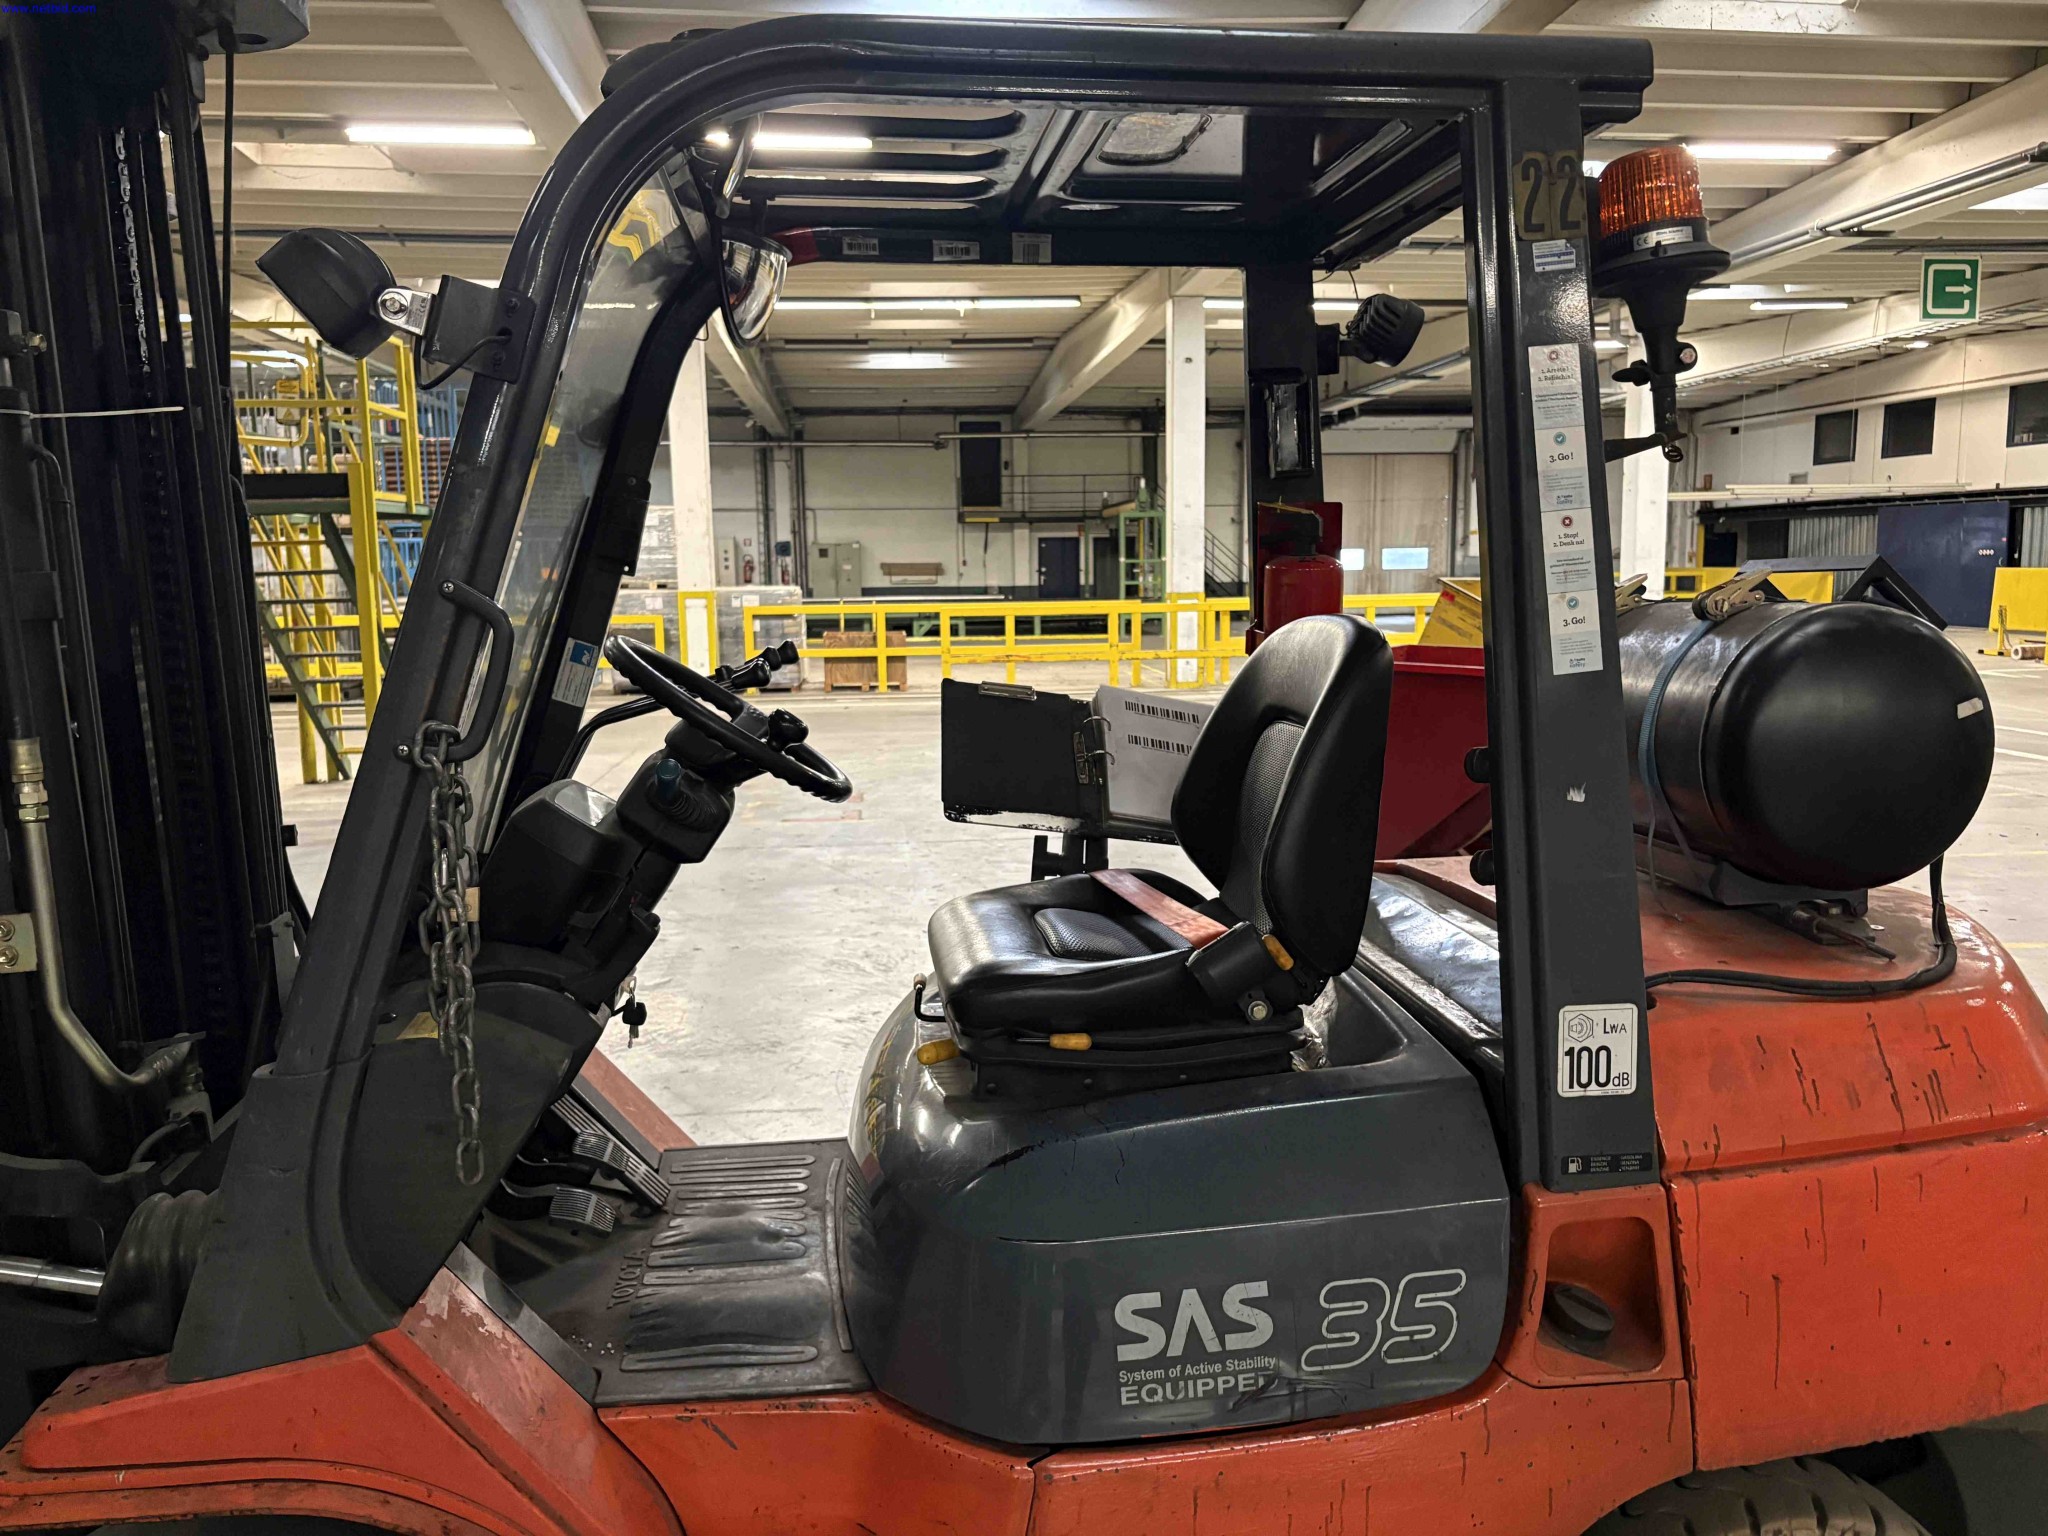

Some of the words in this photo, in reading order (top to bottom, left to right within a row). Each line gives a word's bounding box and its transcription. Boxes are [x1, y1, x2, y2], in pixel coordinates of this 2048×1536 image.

[1521, 155, 1581, 233] 22
[1549, 455, 1557, 463] 3.
[1563, 532, 1579, 540] Stop!
[1563, 619, 1571, 627] 3.
[1571, 616, 1586, 625] Go!
[606, 1248, 647, 1310] TOYOTA
[1114, 1280, 1274, 1362] SAS
[1301, 1268, 1467, 1372] 35
[1119, 1368, 1165, 1385] System
[1168, 1364, 1182, 1378] of
[1184, 1361, 1222, 1376] Active
[1225, 1355, 1276, 1371] Stability
